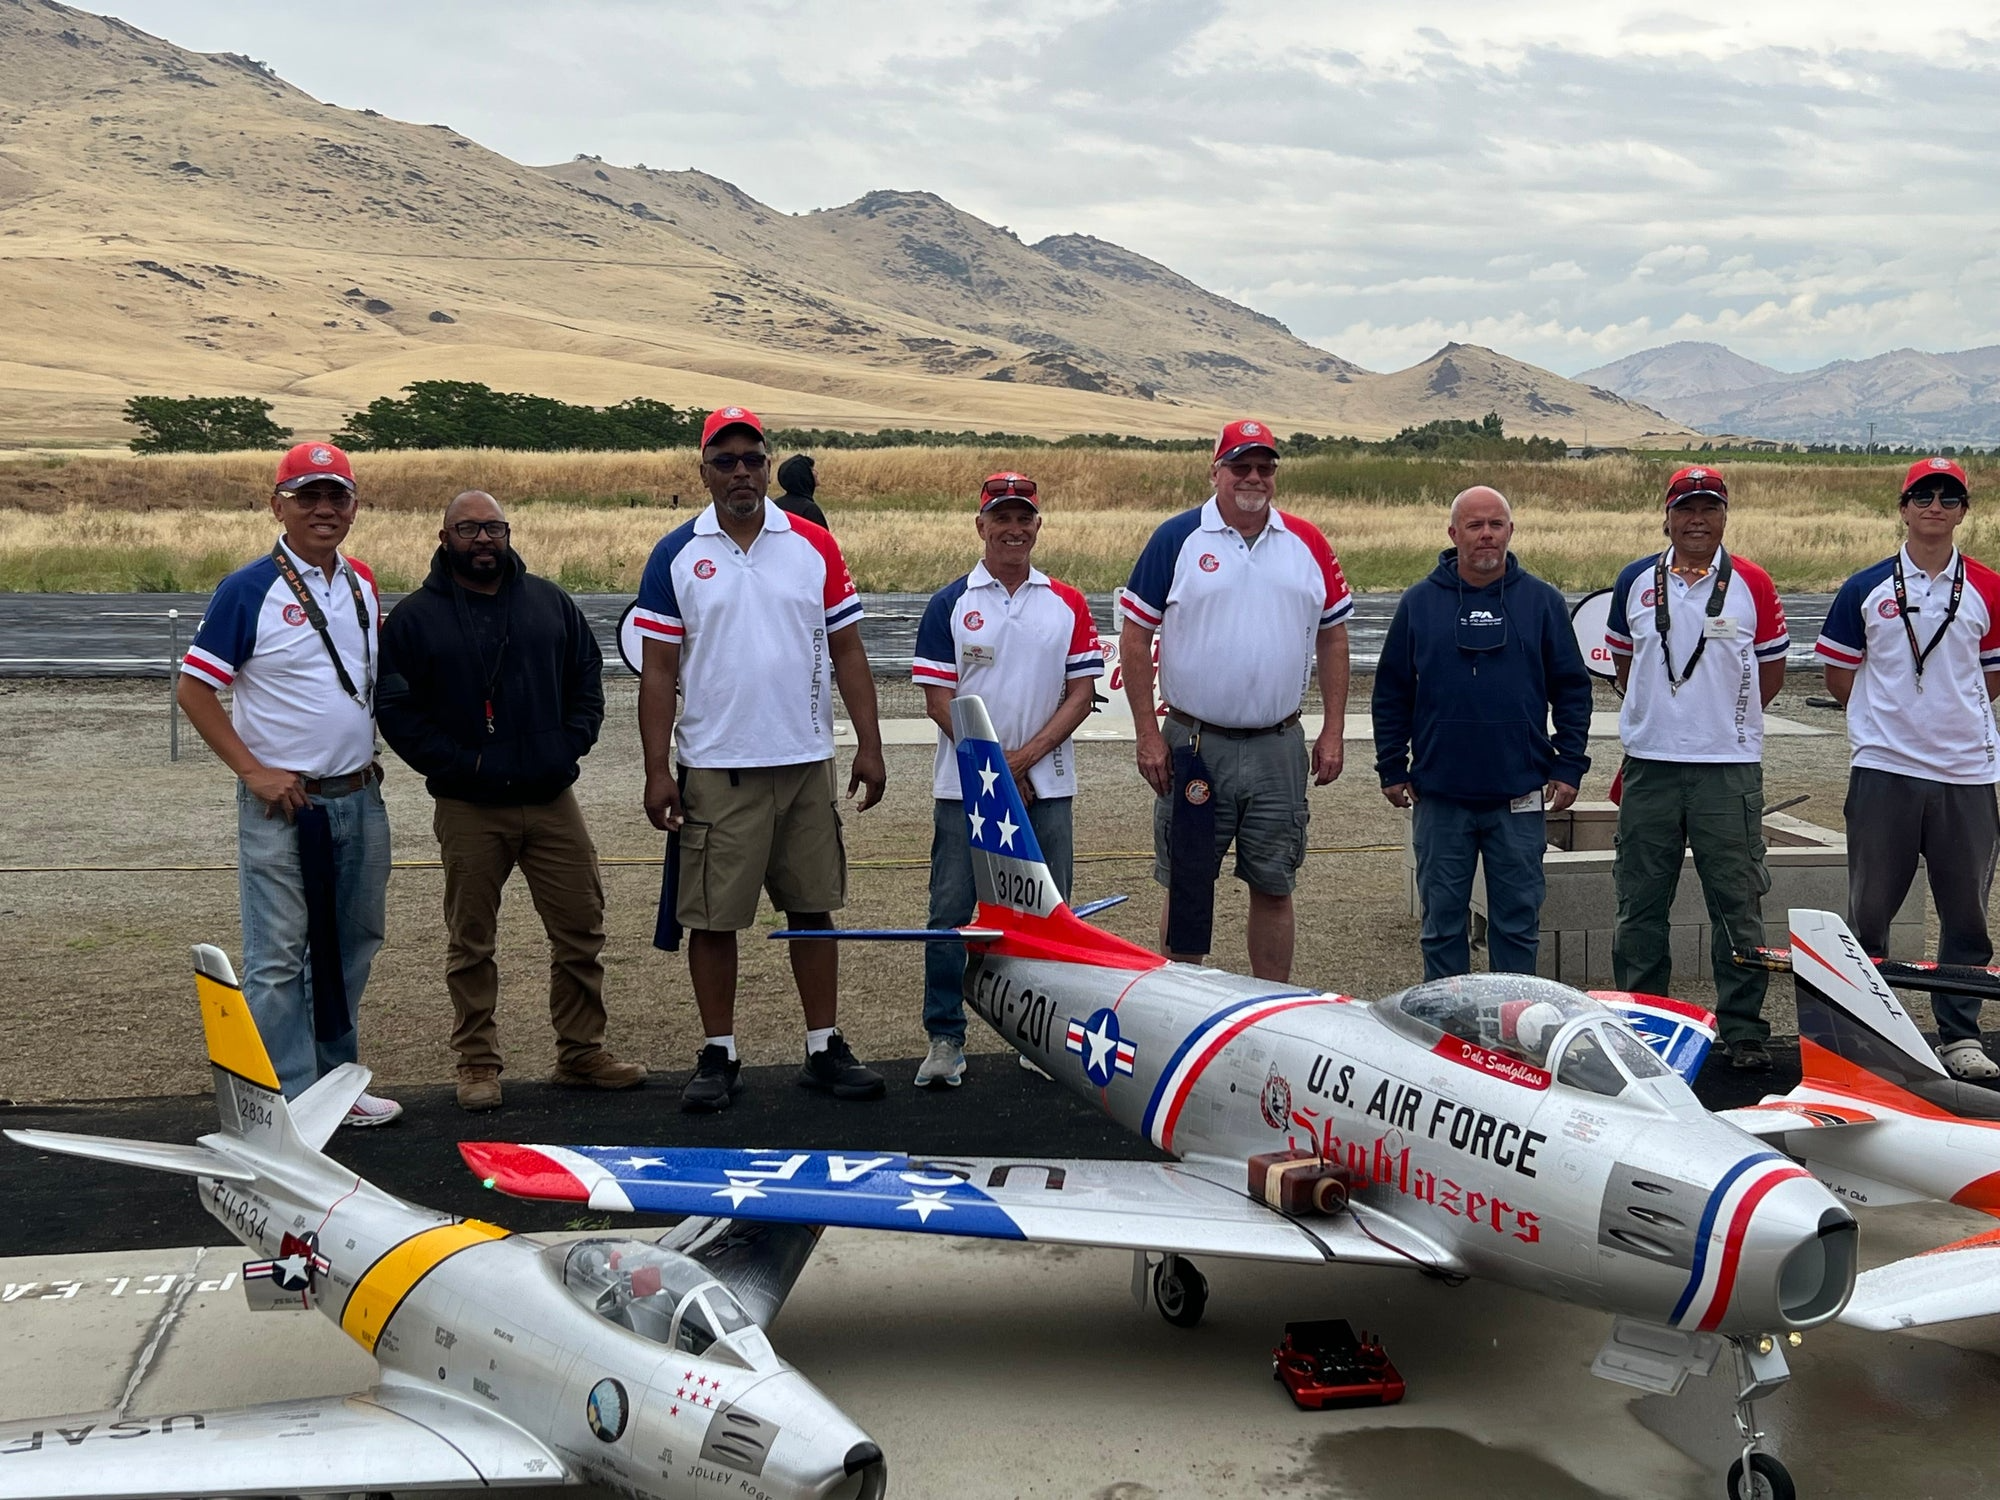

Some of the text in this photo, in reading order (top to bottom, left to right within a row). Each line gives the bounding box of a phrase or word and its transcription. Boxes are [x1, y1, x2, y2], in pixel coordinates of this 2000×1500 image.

[998, 870, 1043, 910] 31201
[977, 969, 1057, 1054] FU-201
[1462, 1044, 1484, 1065] Dale
[1307, 1054, 1355, 1109] U.S.
[1366, 1079, 1423, 1132] AIR
[1428, 1098, 1547, 1179] FORCE
[723, 1154, 1067, 1191] USAF
[0, 1414, 205, 1454] USAF
[687, 1466, 733, 1485] JOLLEY
